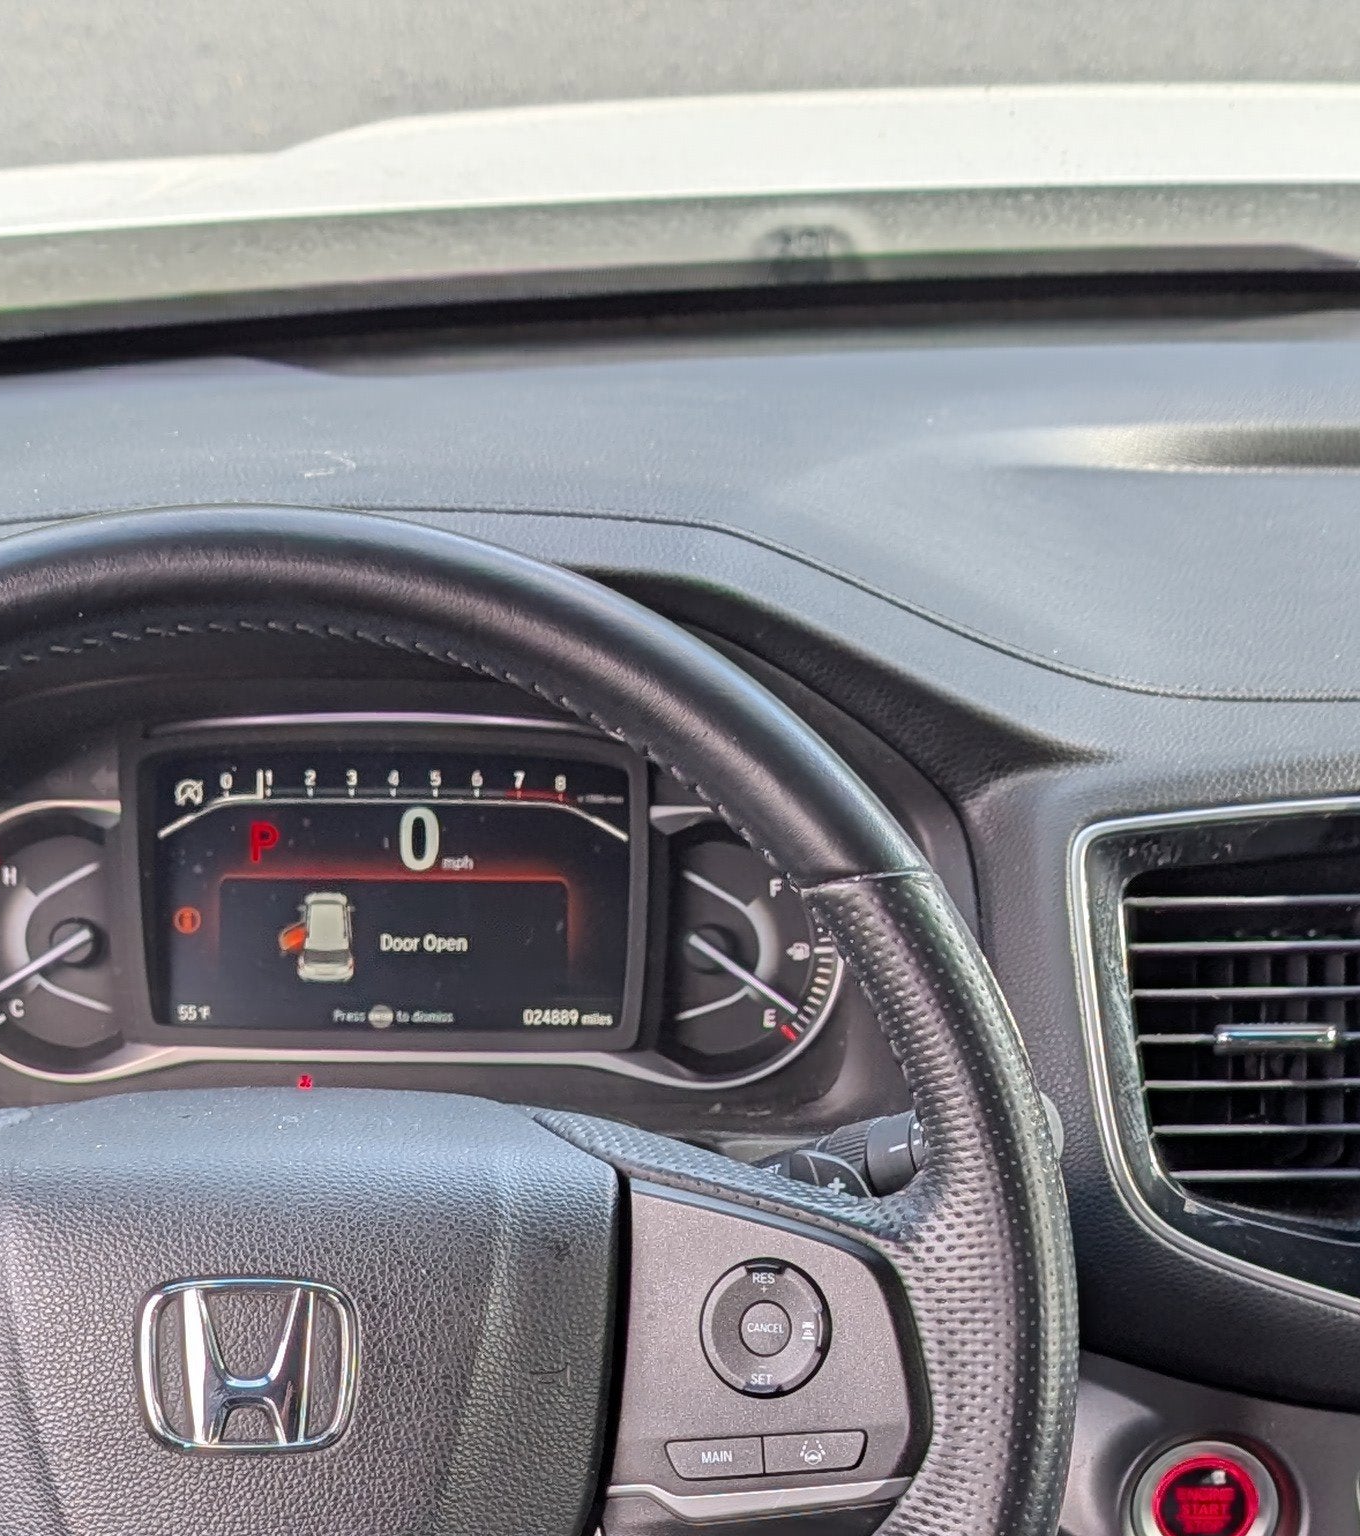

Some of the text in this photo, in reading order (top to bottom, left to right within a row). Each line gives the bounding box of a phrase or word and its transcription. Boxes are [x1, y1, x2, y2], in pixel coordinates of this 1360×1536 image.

[220, 772, 233, 789] 0
[265, 769, 273, 786] 1
[304, 769, 317, 786] 2
[346, 769, 358, 786] 3
[388, 769, 400, 786] 4
[430, 770, 441, 786] 5
[472, 770, 483, 786] 6
[514, 770, 526, 789] 7
[554, 774, 567, 791] 8
[250, 821, 280, 864] P
[400, 807, 474, 871] 0 mph
[1, 865, 18, 886] H
[769, 878, 783, 897] F
[380, 933, 468, 952] Door Open
[9, 998, 25, 1018] C
[333, 1009, 366, 1023] Press
[396, 1010, 409, 1022] to
[581, 1012, 613, 1026] miles
[763, 1008, 777, 1028] E
[752, 1272, 775, 1284] RES
[746, 1322, 785, 1334] CANCEL
[750, 1373, 773, 1386] SET
[701, 1451, 733, 1464] MAIN
[1181, 1502, 1229, 1516] START
